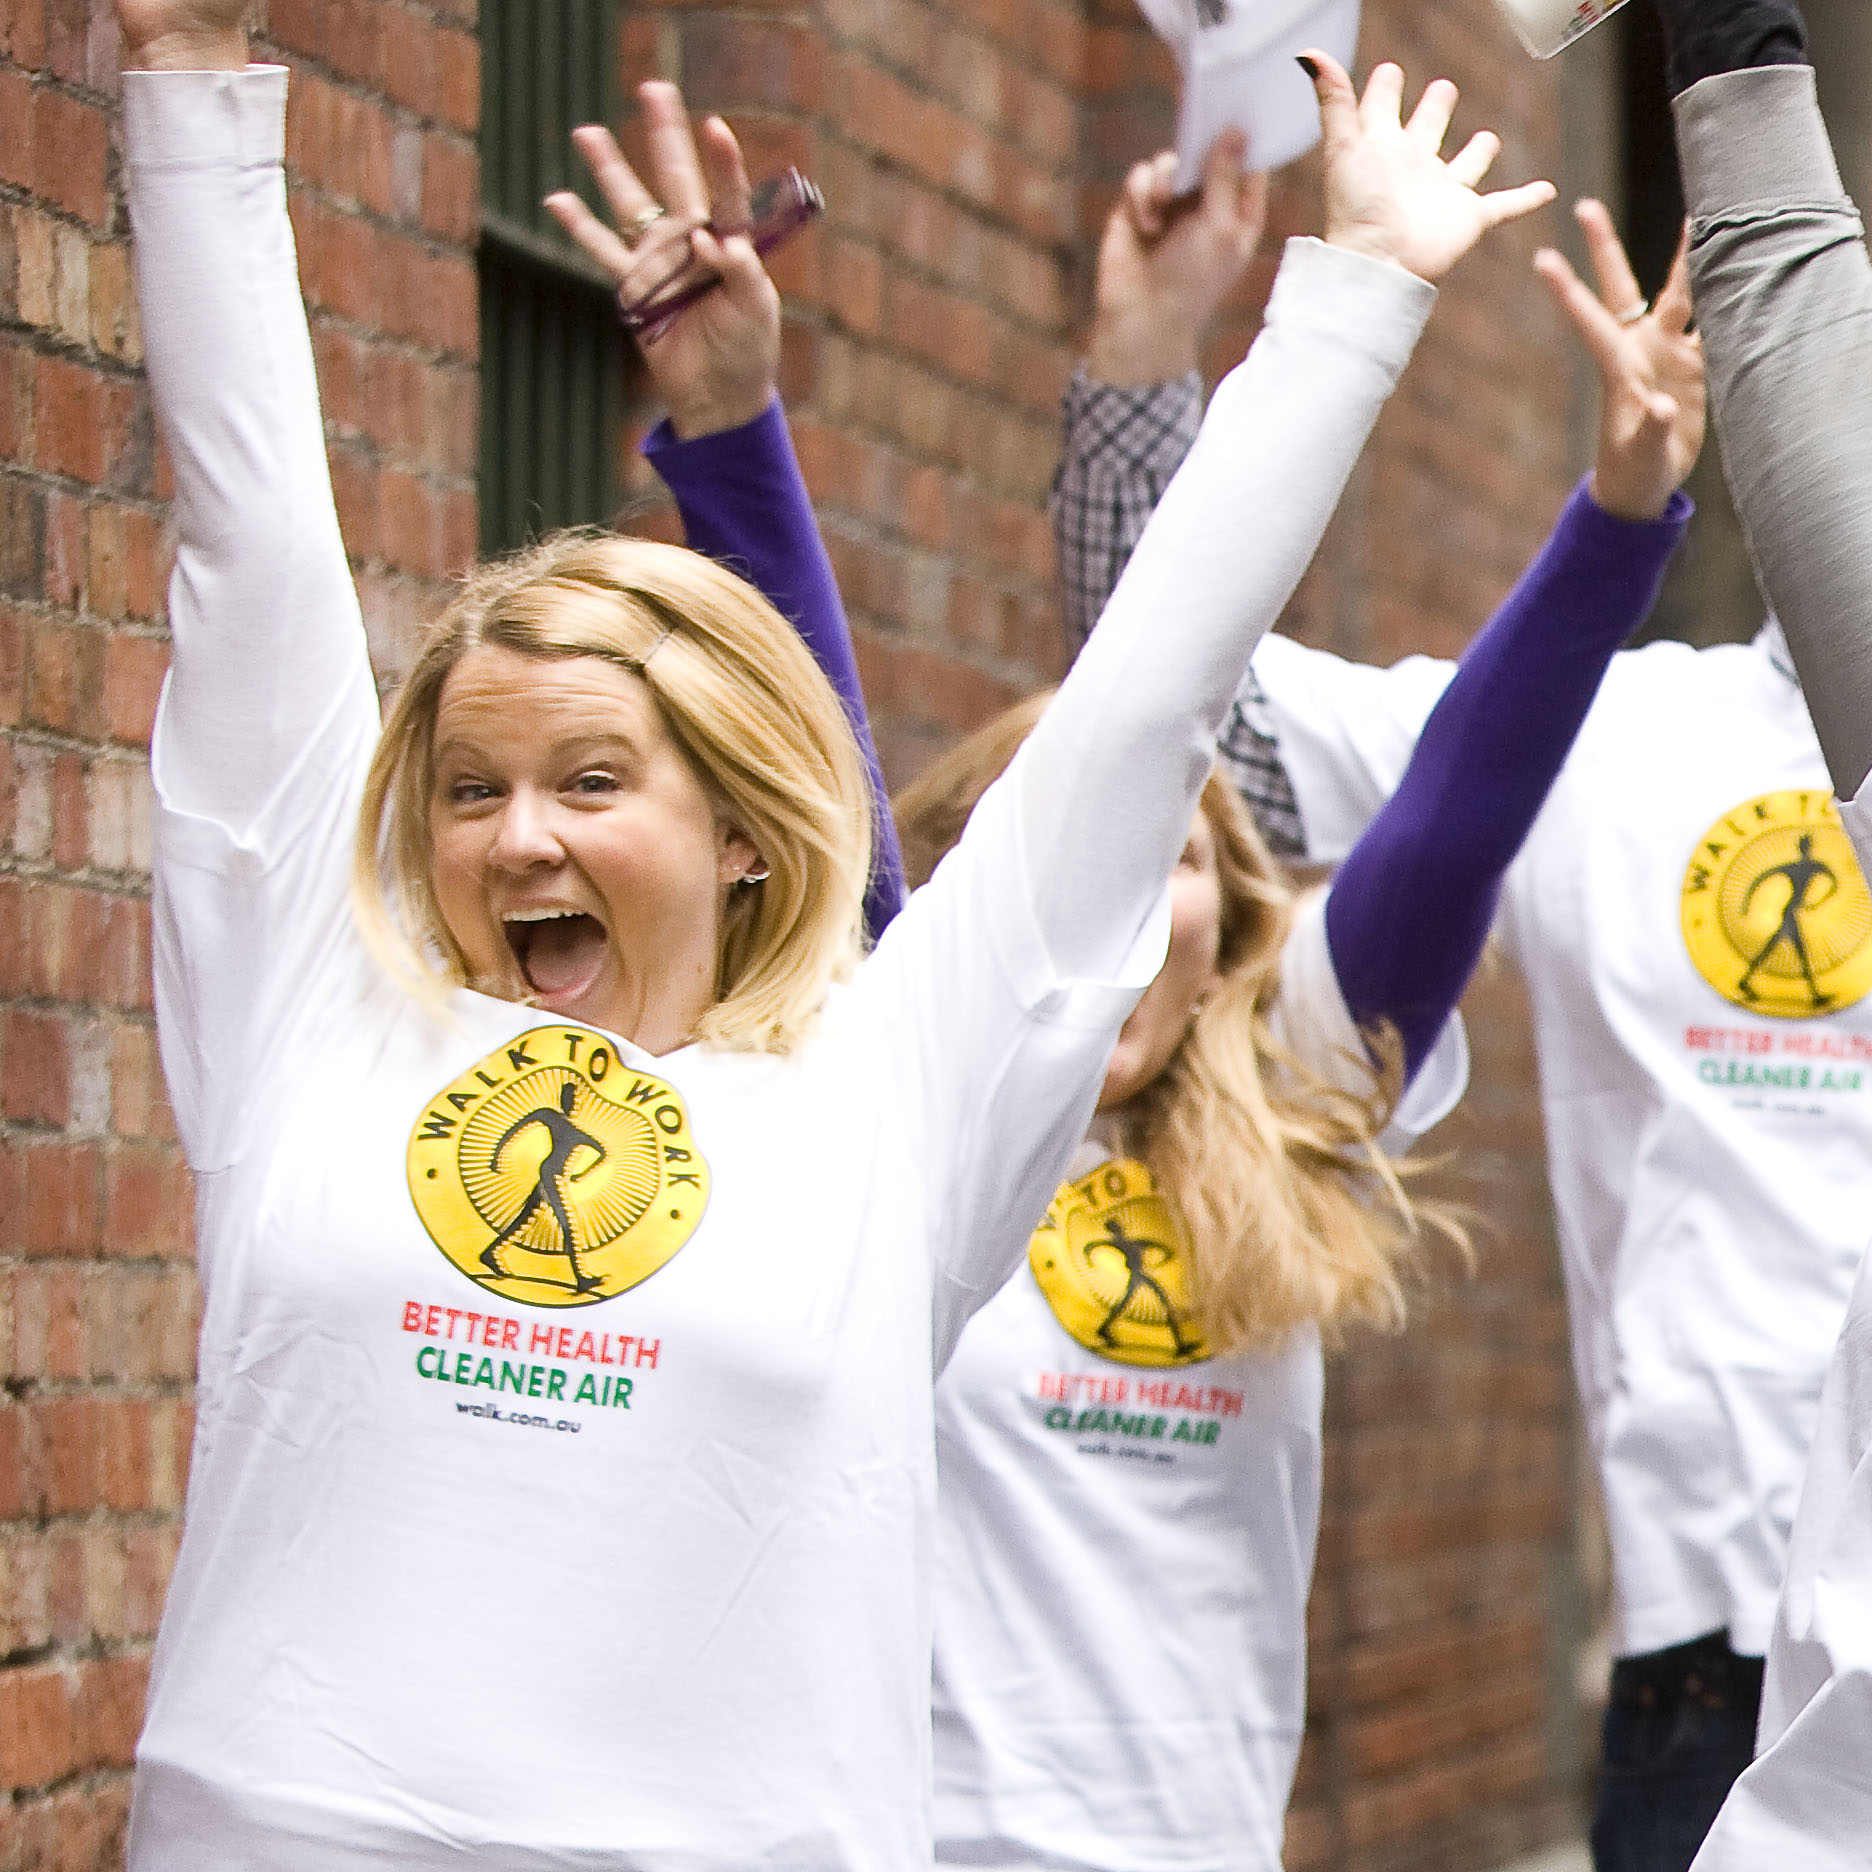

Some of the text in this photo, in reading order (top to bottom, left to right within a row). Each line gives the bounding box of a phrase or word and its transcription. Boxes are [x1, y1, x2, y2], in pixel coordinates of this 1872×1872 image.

[418, 1033, 701, 1190] WALK TO WORK
[402, 1301, 663, 1369] BETTER HEALTH
[417, 1346, 634, 1410] CLEANER AIR
[455, 1402, 582, 1434] walk.com.au
